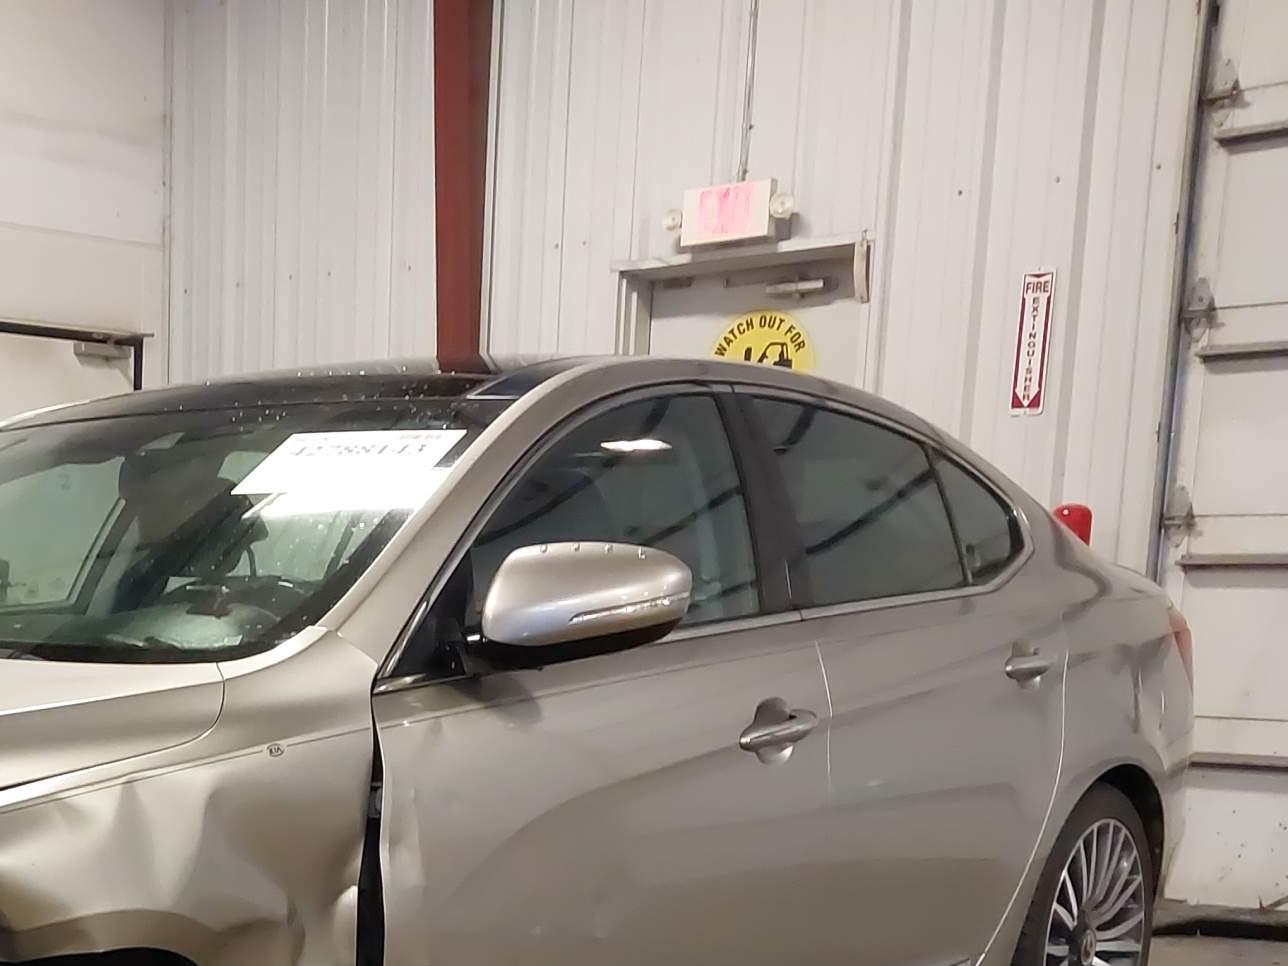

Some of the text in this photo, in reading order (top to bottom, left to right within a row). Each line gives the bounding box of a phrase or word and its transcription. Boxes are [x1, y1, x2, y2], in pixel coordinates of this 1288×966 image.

[1025, 281, 1049, 294] FIRE
[714, 315, 806, 357] WATCH OUT FOR
